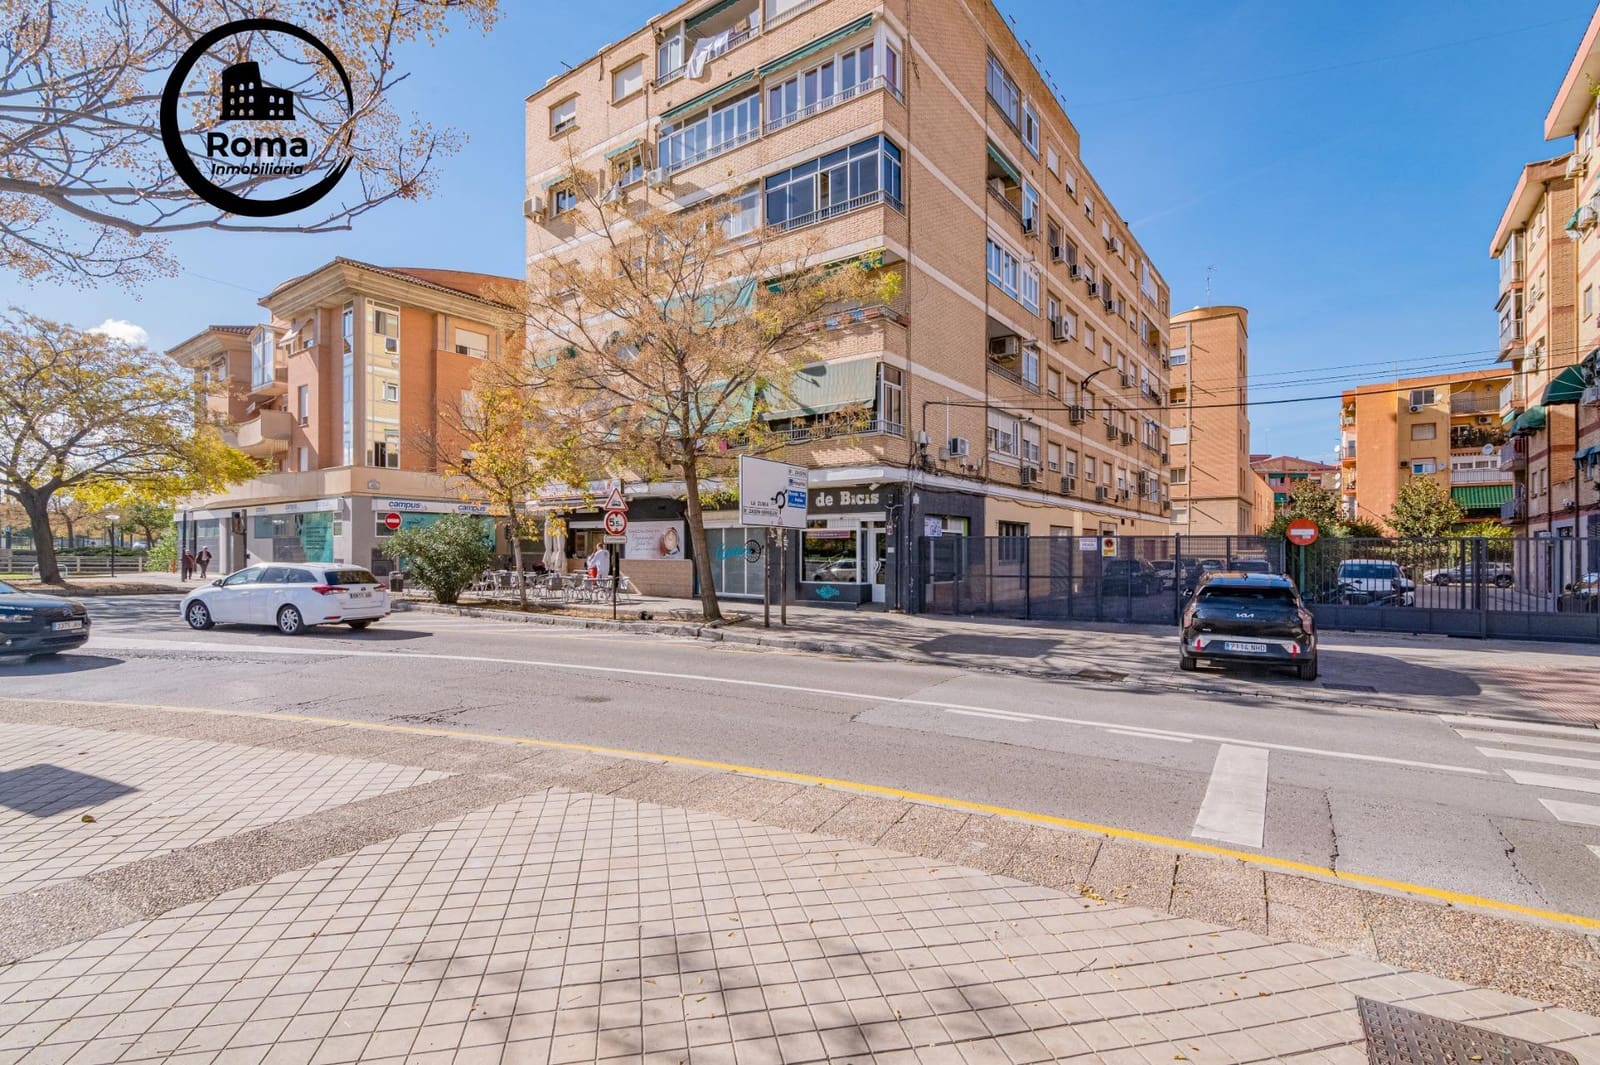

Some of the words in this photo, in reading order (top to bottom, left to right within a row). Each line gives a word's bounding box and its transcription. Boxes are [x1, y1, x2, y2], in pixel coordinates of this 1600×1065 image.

[815, 491, 834, 507] de
[388, 500, 421, 510] campus
[457, 503, 487, 513] campus
